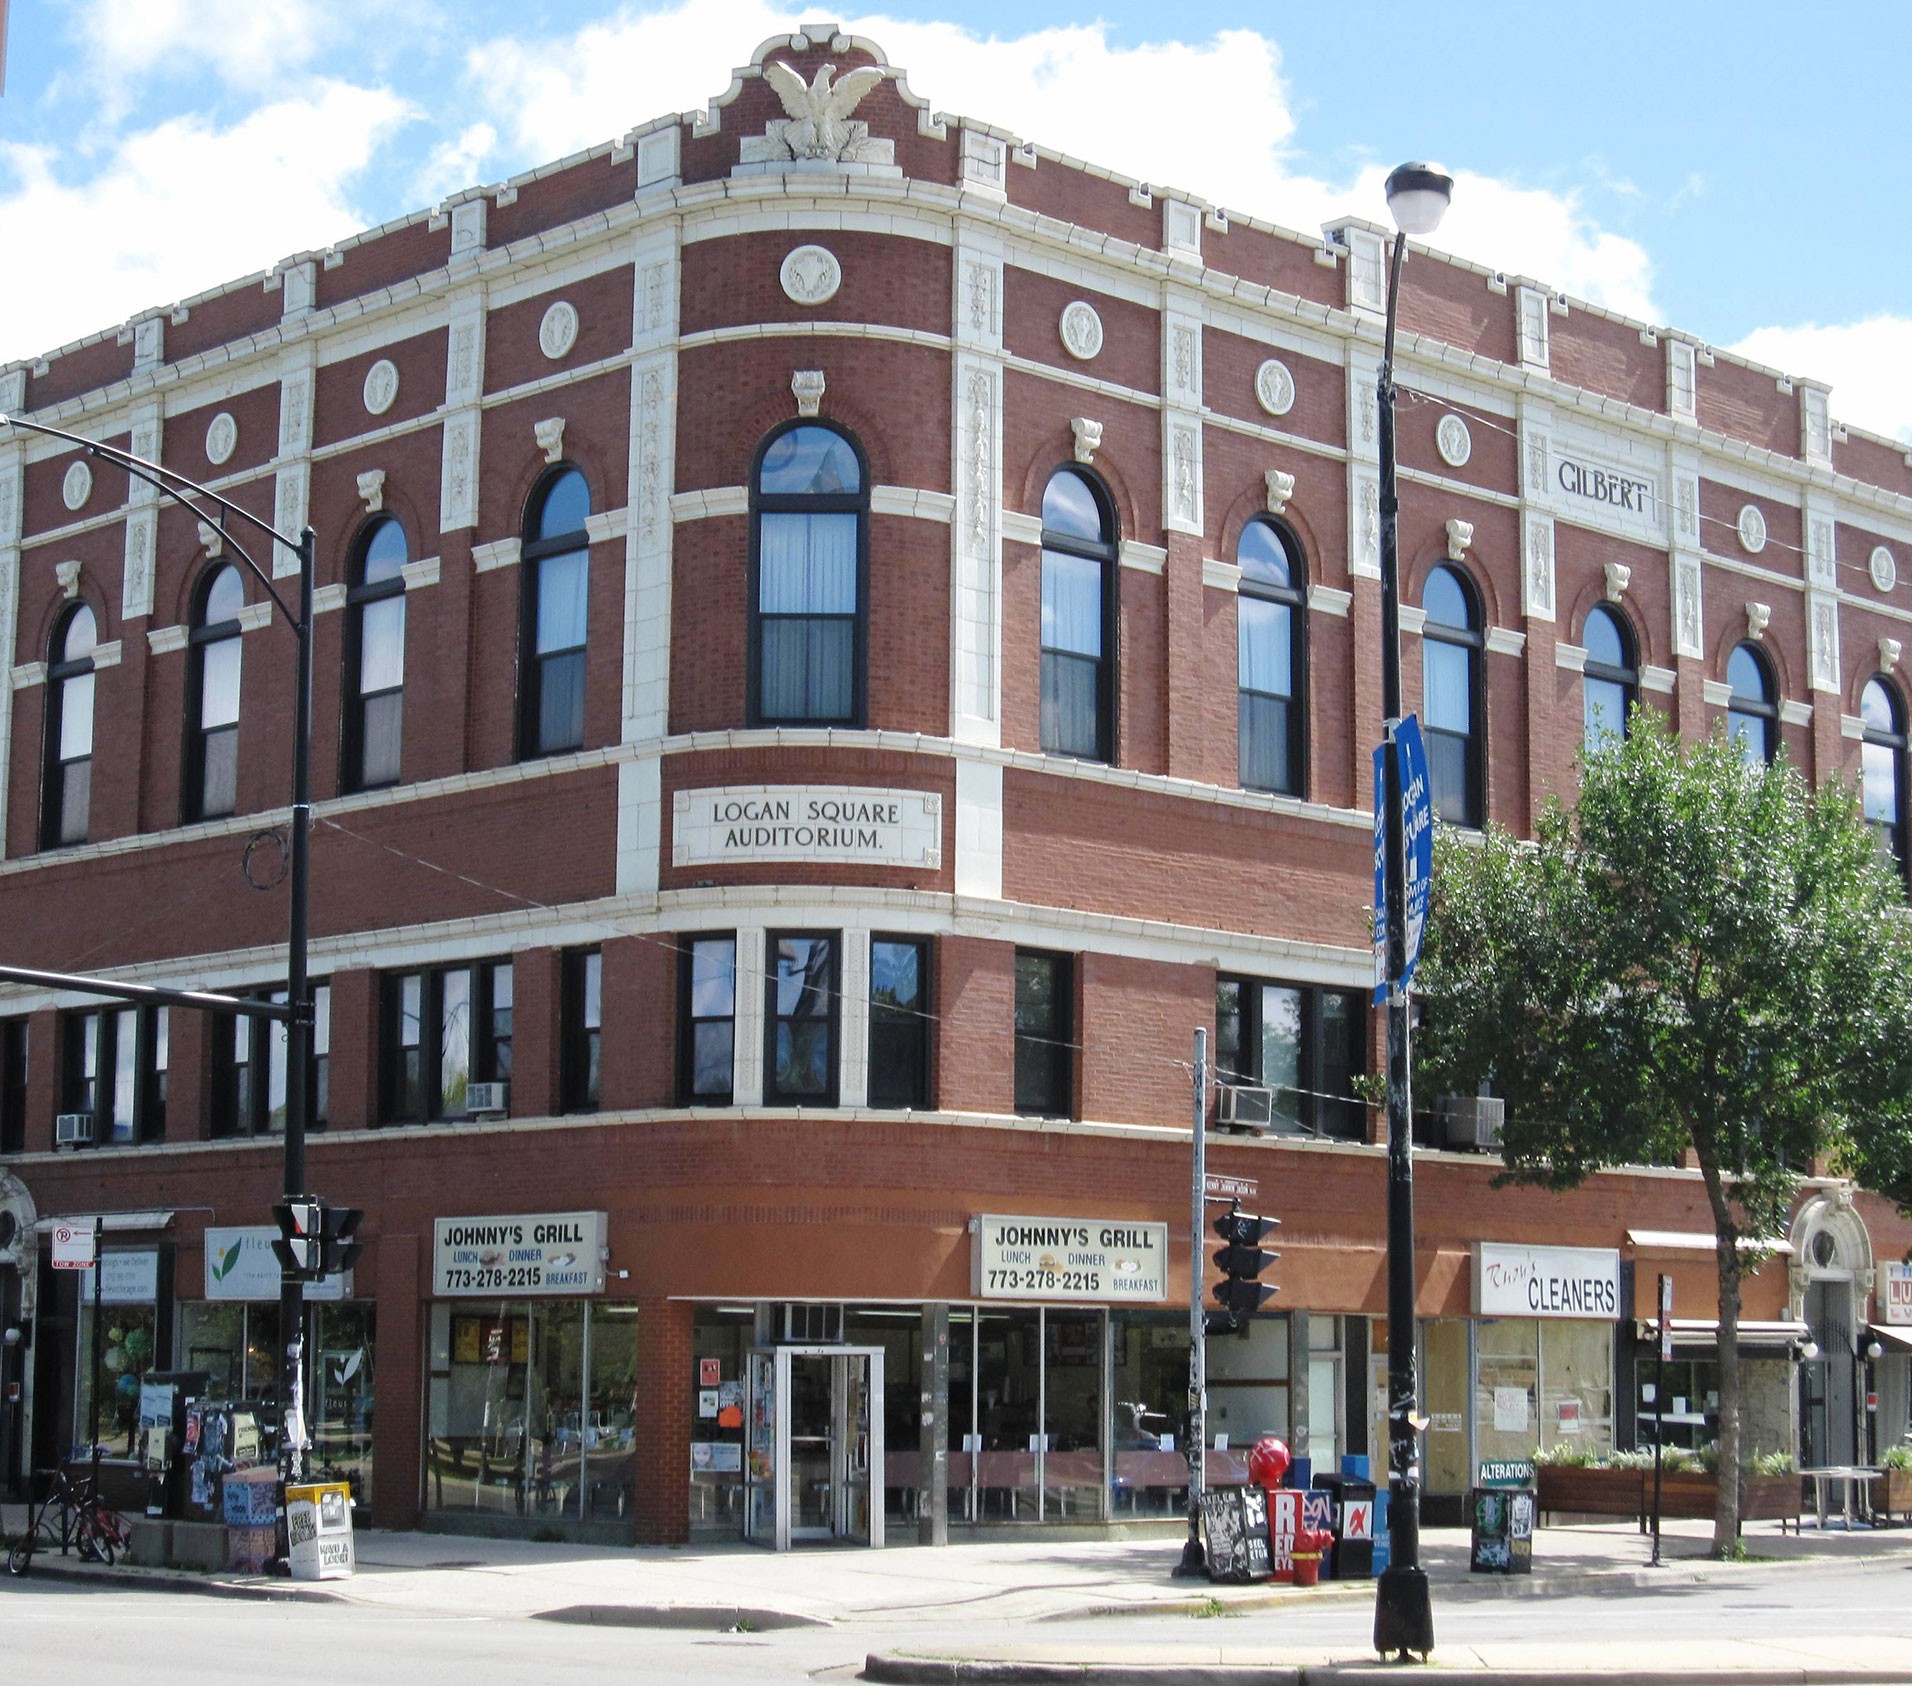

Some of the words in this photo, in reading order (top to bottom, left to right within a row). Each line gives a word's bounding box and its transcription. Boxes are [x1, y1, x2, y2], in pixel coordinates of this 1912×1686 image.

[1558, 460, 1648, 513] GILBERT
[713, 801, 790, 823] LOGAN
[807, 800, 900, 825] SQUARE
[724, 826, 883, 850] AUDITORIUM.
[245, 1236, 271, 1251] fleu
[444, 1226, 523, 1246] JOHNNY'S
[533, 1224, 583, 1244] GRILL
[996, 1226, 1089, 1247] JOHNNY'S
[1100, 1229, 1154, 1249] GRILL
[453, 1251, 478, 1264] LUNCH
[508, 1249, 542, 1262] DINNER
[1001, 1250, 1031, 1264] LUNCH
[1068, 1253, 1105, 1267] DINNER
[446, 1267, 541, 1288] 773-278-2215
[545, 1271, 588, 1285] BREAKFAST
[988, 1269, 1100, 1291] 773-278-2215
[1113, 1278, 1158, 1292] BREAKFAST
[1528, 1276, 1615, 1313] CLEANERS
[1481, 1463, 1535, 1480] ALTERATIONS
